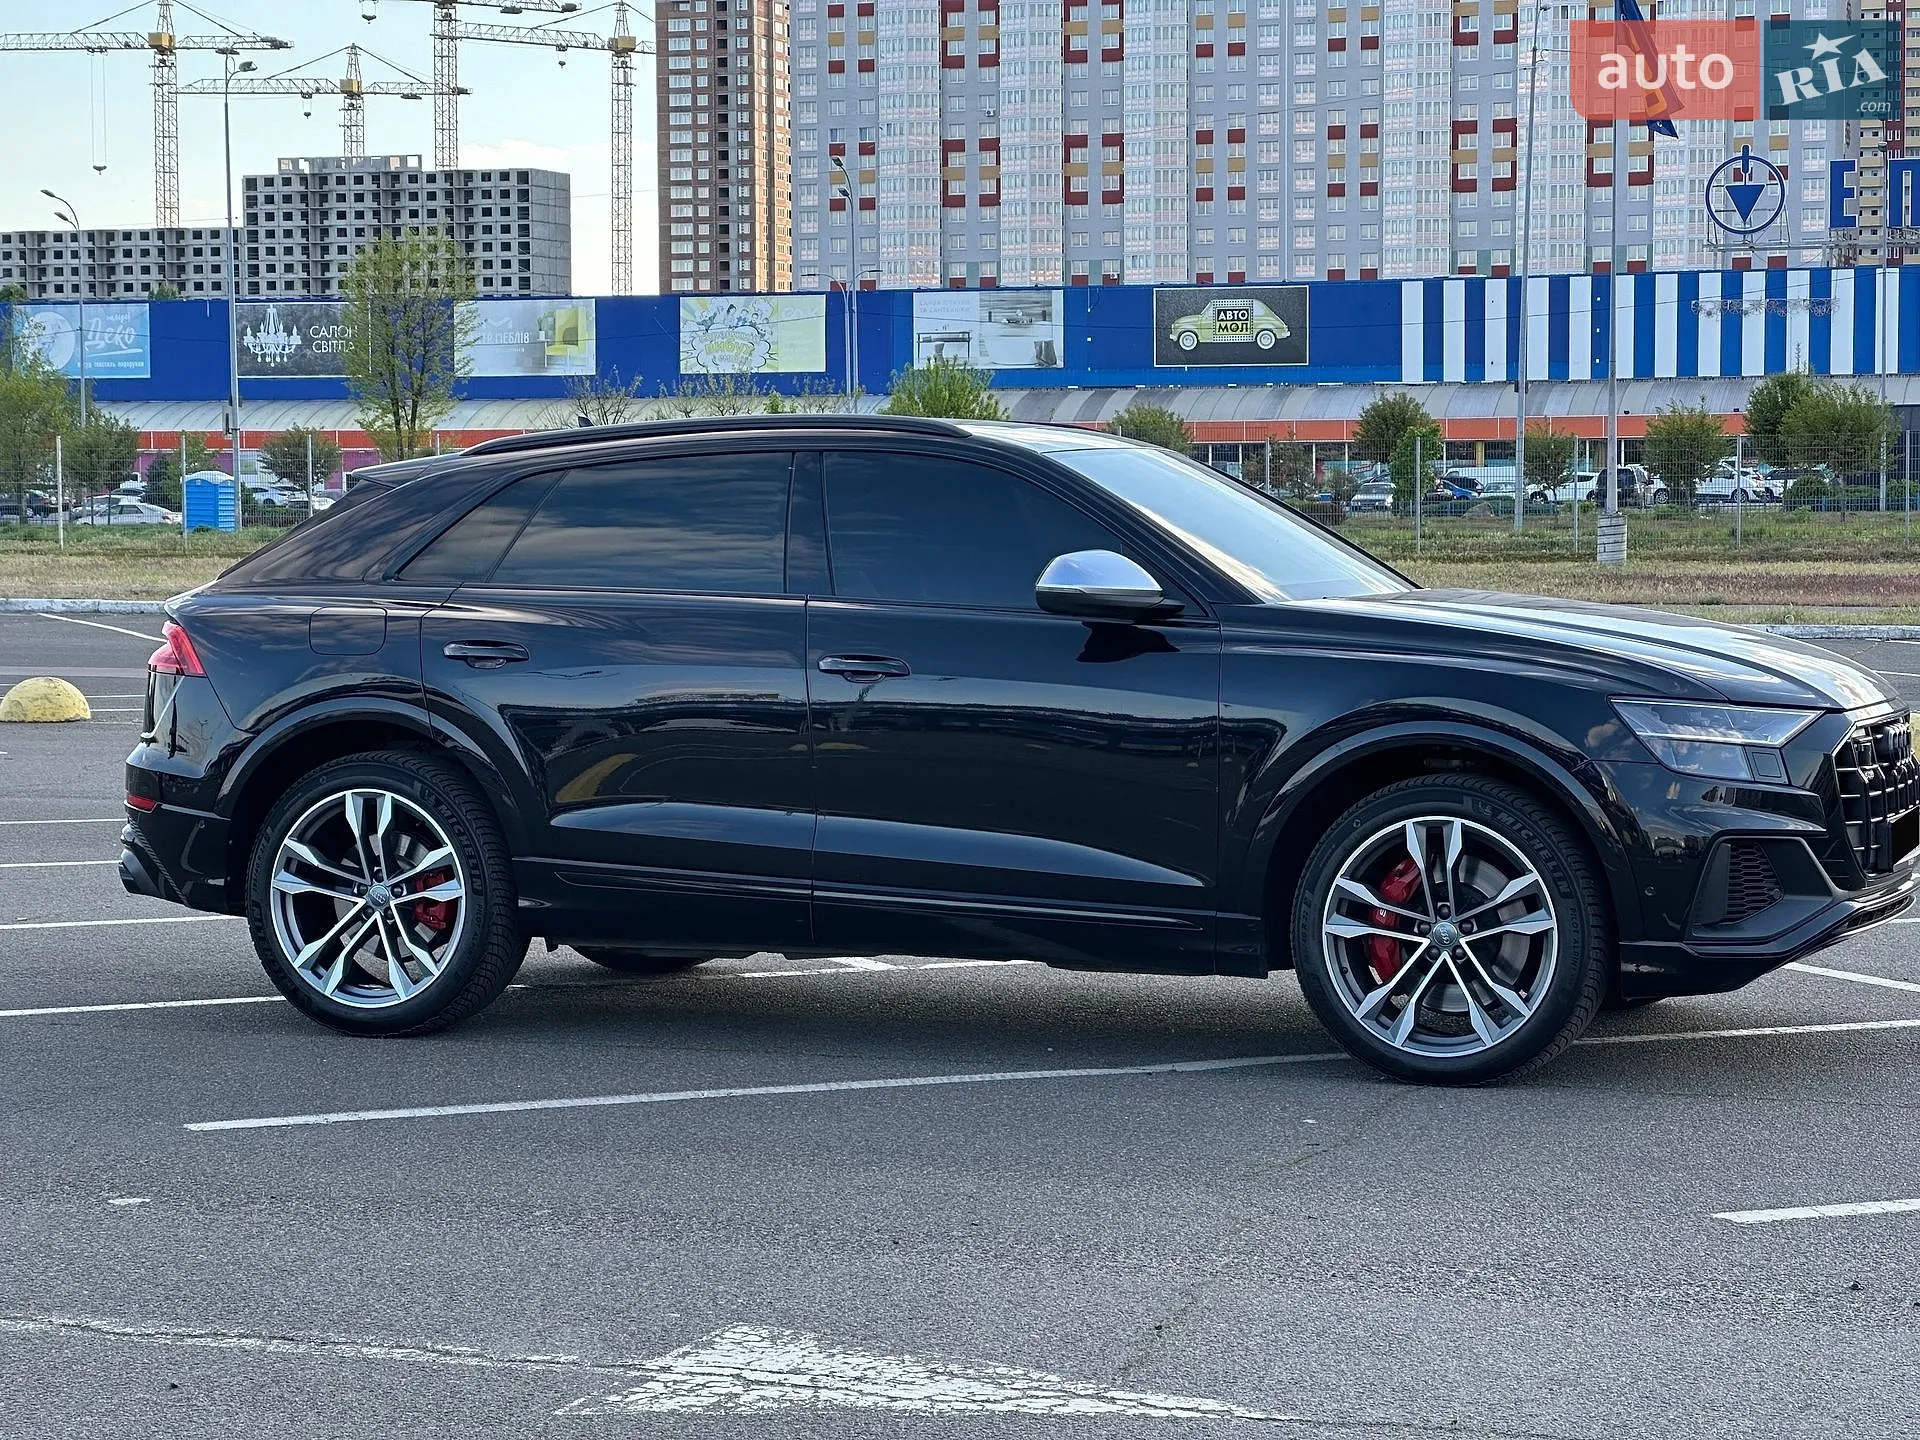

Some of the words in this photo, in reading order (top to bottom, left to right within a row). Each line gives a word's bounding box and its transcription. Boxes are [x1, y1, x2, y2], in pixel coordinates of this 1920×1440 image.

[1217, 308, 1249, 321] АВТО
[309, 325, 358, 338] САЛОН
[1217, 321, 1250, 335] МОЛ
[1495, 812, 1572, 896] MICHELIN
